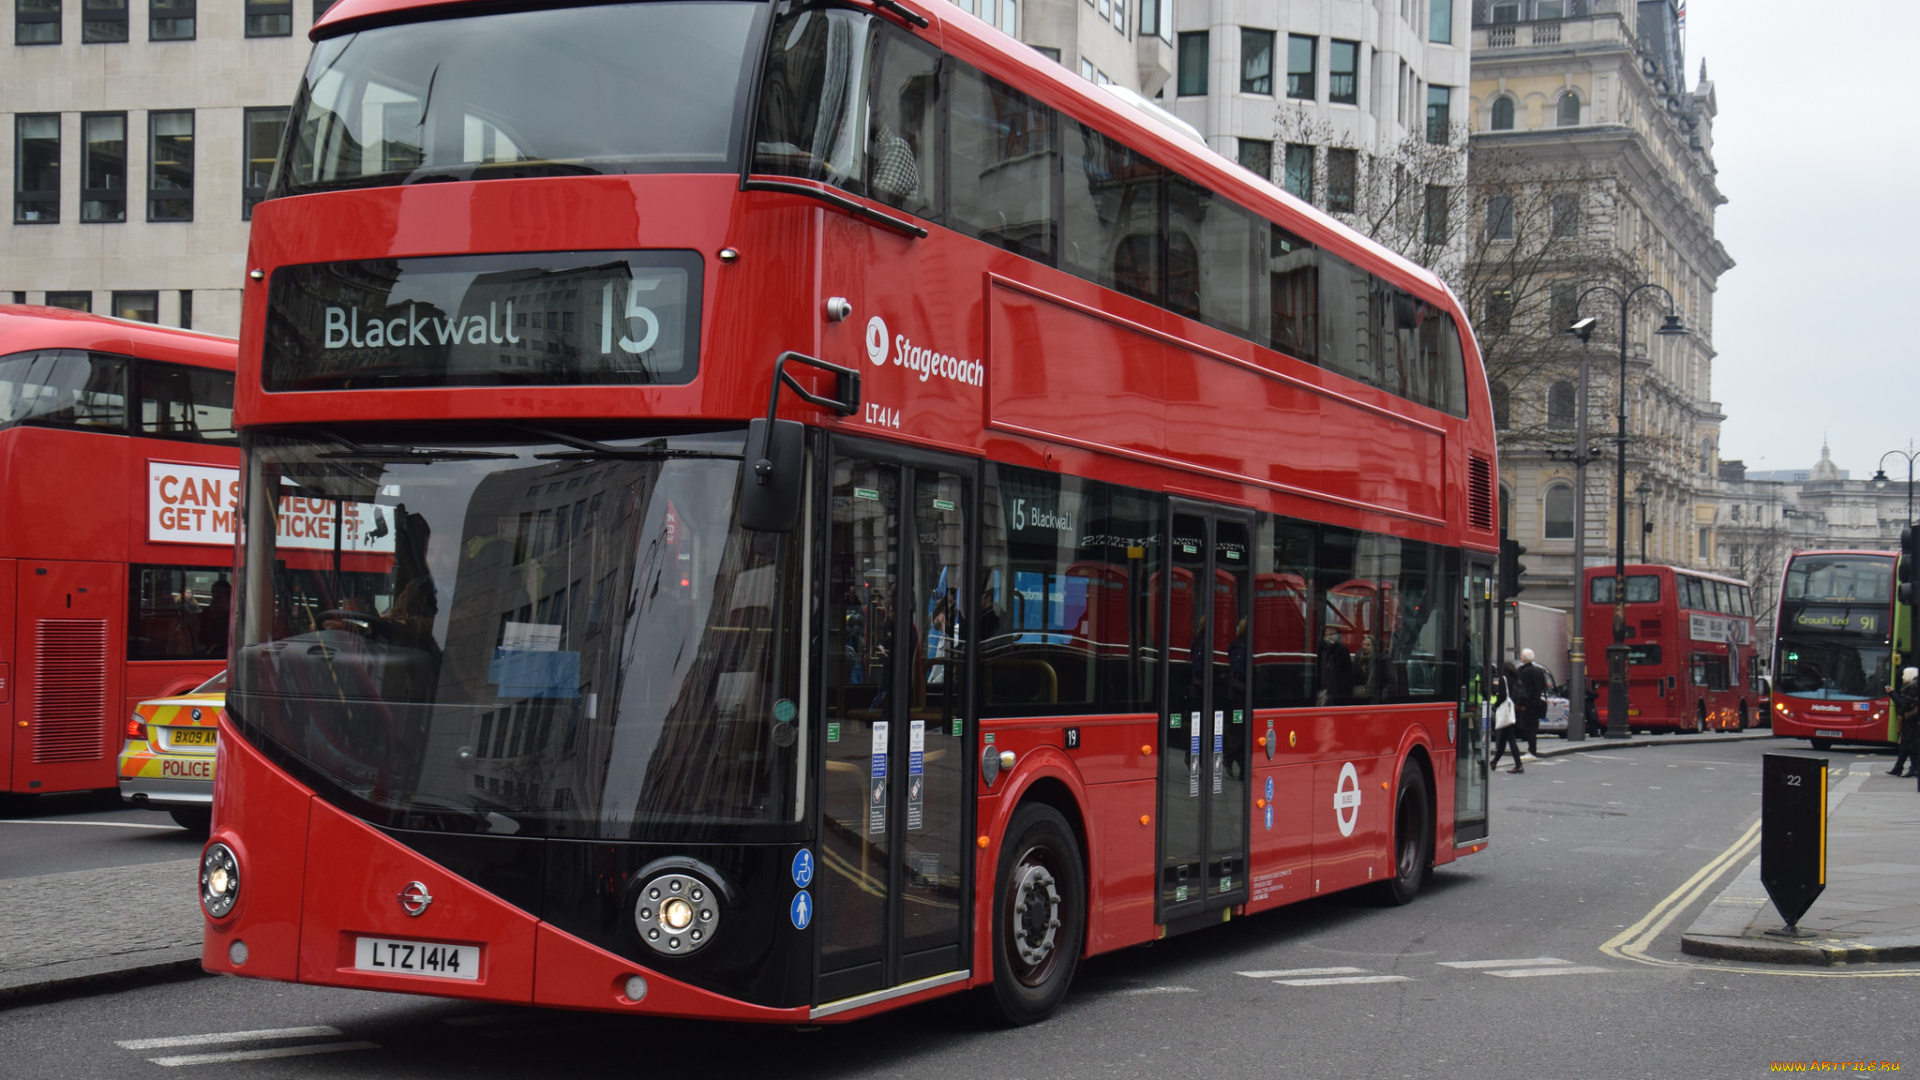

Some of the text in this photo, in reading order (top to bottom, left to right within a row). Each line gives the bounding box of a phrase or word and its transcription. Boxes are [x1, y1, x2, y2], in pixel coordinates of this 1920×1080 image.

[325, 300, 519, 348] Blackwall
[601, 279, 661, 354] 15
[893, 334, 984, 387] Stagecoach
[865, 402, 900, 429] LT414
[159, 506, 206, 532] GET
[1012, 499, 1073, 531] 15 Blackwall
[1798, 614, 1874, 630] Crouch End 91
[1811, 703, 1842, 712] Metroline
[175, 731, 202, 743] BX09
[1067, 729, 1077, 746] 19
[163, 761, 210, 777] POLICE
[1787, 774, 1801, 786] 22
